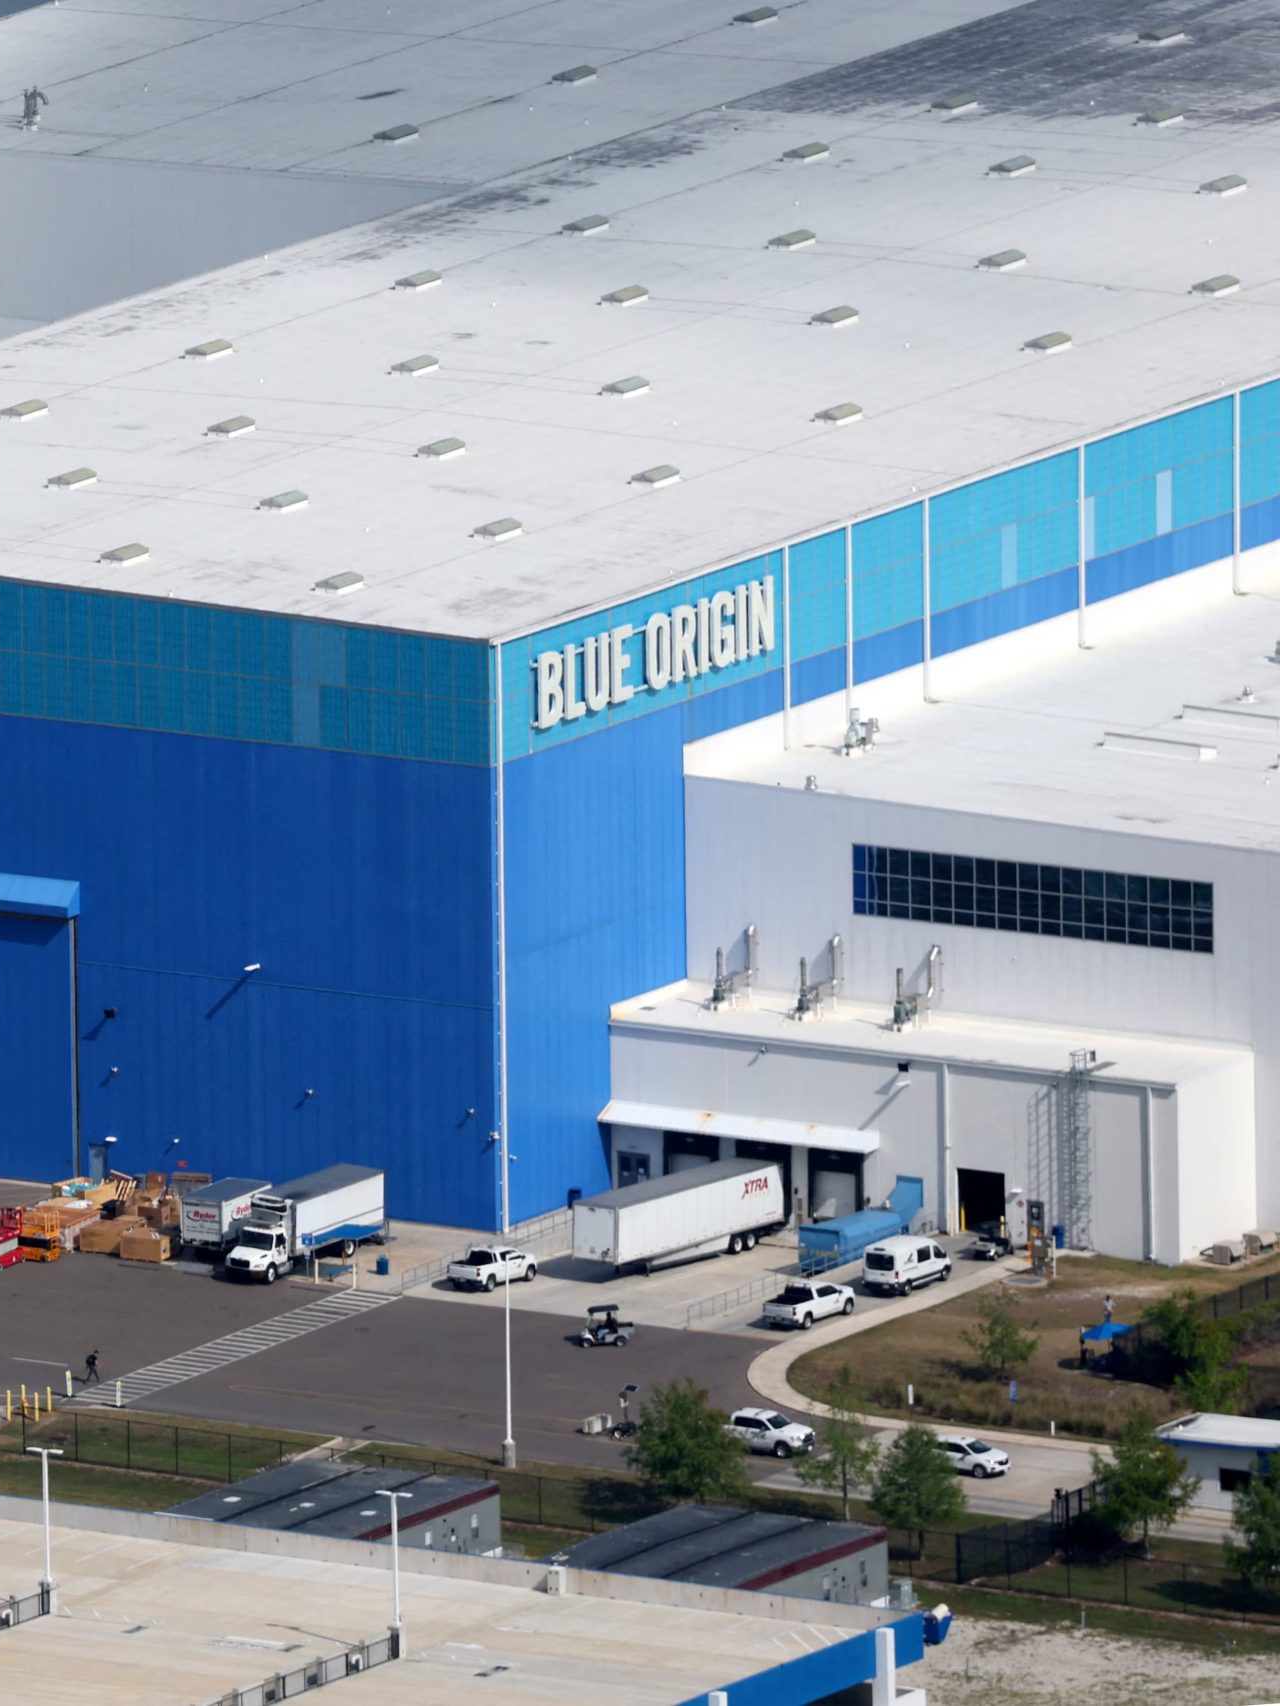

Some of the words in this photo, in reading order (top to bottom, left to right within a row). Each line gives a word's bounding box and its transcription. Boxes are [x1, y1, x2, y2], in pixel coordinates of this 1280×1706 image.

[536, 622, 636, 730] BLUE
[645, 575, 775, 691] ORIGIN
[741, 1176, 768, 1200] XTRA
[193, 1209, 216, 1220] Ryder
[235, 1203, 252, 1216] Ryde
